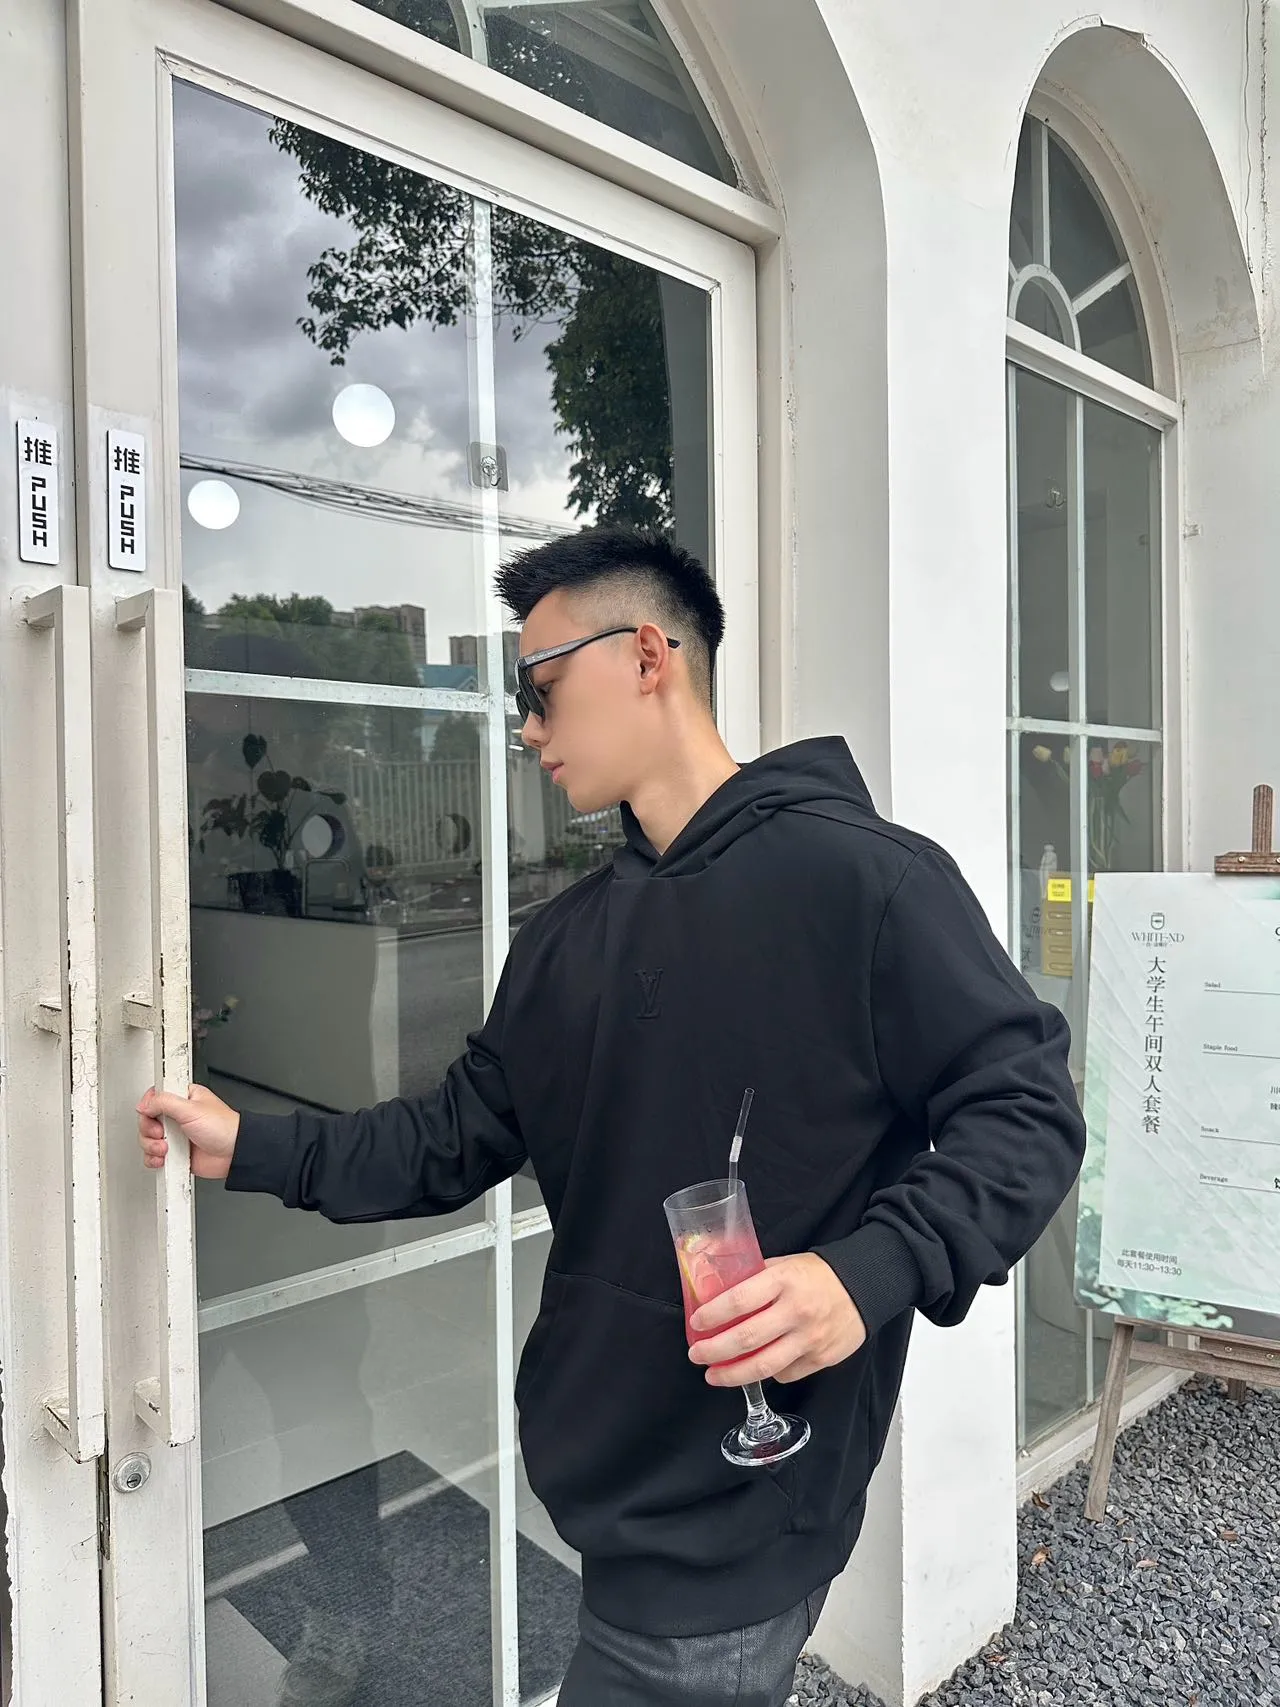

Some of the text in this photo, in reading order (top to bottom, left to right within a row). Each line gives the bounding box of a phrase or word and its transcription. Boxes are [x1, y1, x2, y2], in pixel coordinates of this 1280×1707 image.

[24, 437, 52, 466] 推
[114, 446, 140, 474] 推
[31, 476, 47, 547] PUSH
[120, 485, 135, 554] PUSH
[1142, 956, 1166, 1135] 大学生午间双人套餐
